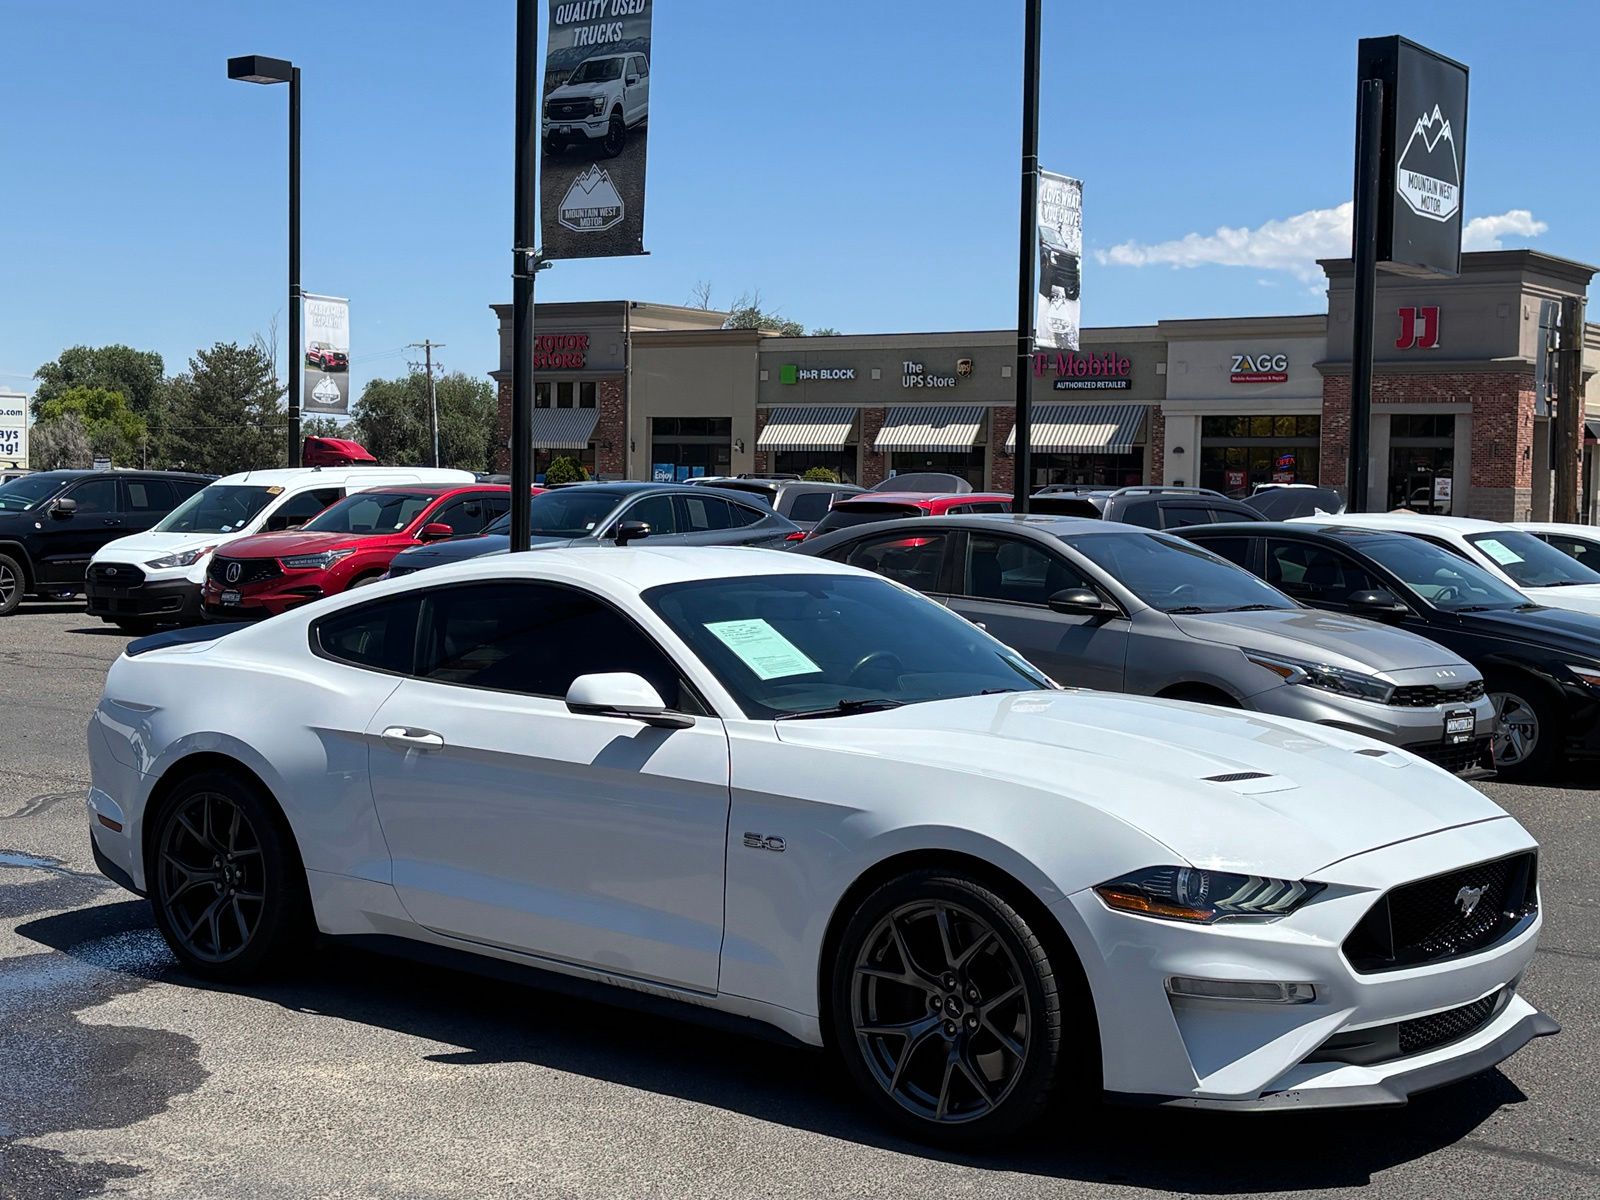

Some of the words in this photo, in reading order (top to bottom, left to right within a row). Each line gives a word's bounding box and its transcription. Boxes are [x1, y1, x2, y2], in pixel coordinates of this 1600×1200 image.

[555, 0, 607, 25] QUALITY
[611, 0, 645, 17] USED
[574, 22, 623, 47] TRUCKS
[1408, 173, 1438, 195] MOUNTAIN
[1439, 181, 1453, 200] WEST
[1042, 188, 1061, 204] LOVE
[1061, 191, 1080, 209] WHAT
[1420, 194, 1441, 213] MOTOR
[565, 208, 599, 219] MOUNTAIN
[600, 207, 617, 217] WEST
[1059, 207, 1079, 227] DRIVE
[580, 217, 603, 227] MOTOR
[534, 334, 589, 353] IQUOR
[902, 361, 923, 374] The
[1231, 354, 1288, 373] ZAGG
[800, 369, 818, 380] H&R
[820, 369, 856, 380] BLOCK
[902, 375, 924, 388] UPS
[926, 374, 956, 388] Store
[1056, 381, 1096, 389] AUTHORIZED
[1097, 381, 1127, 389] RETAILER
[1275, 457, 1296, 467] OPEN
[654, 469, 673, 483] Enjoy
